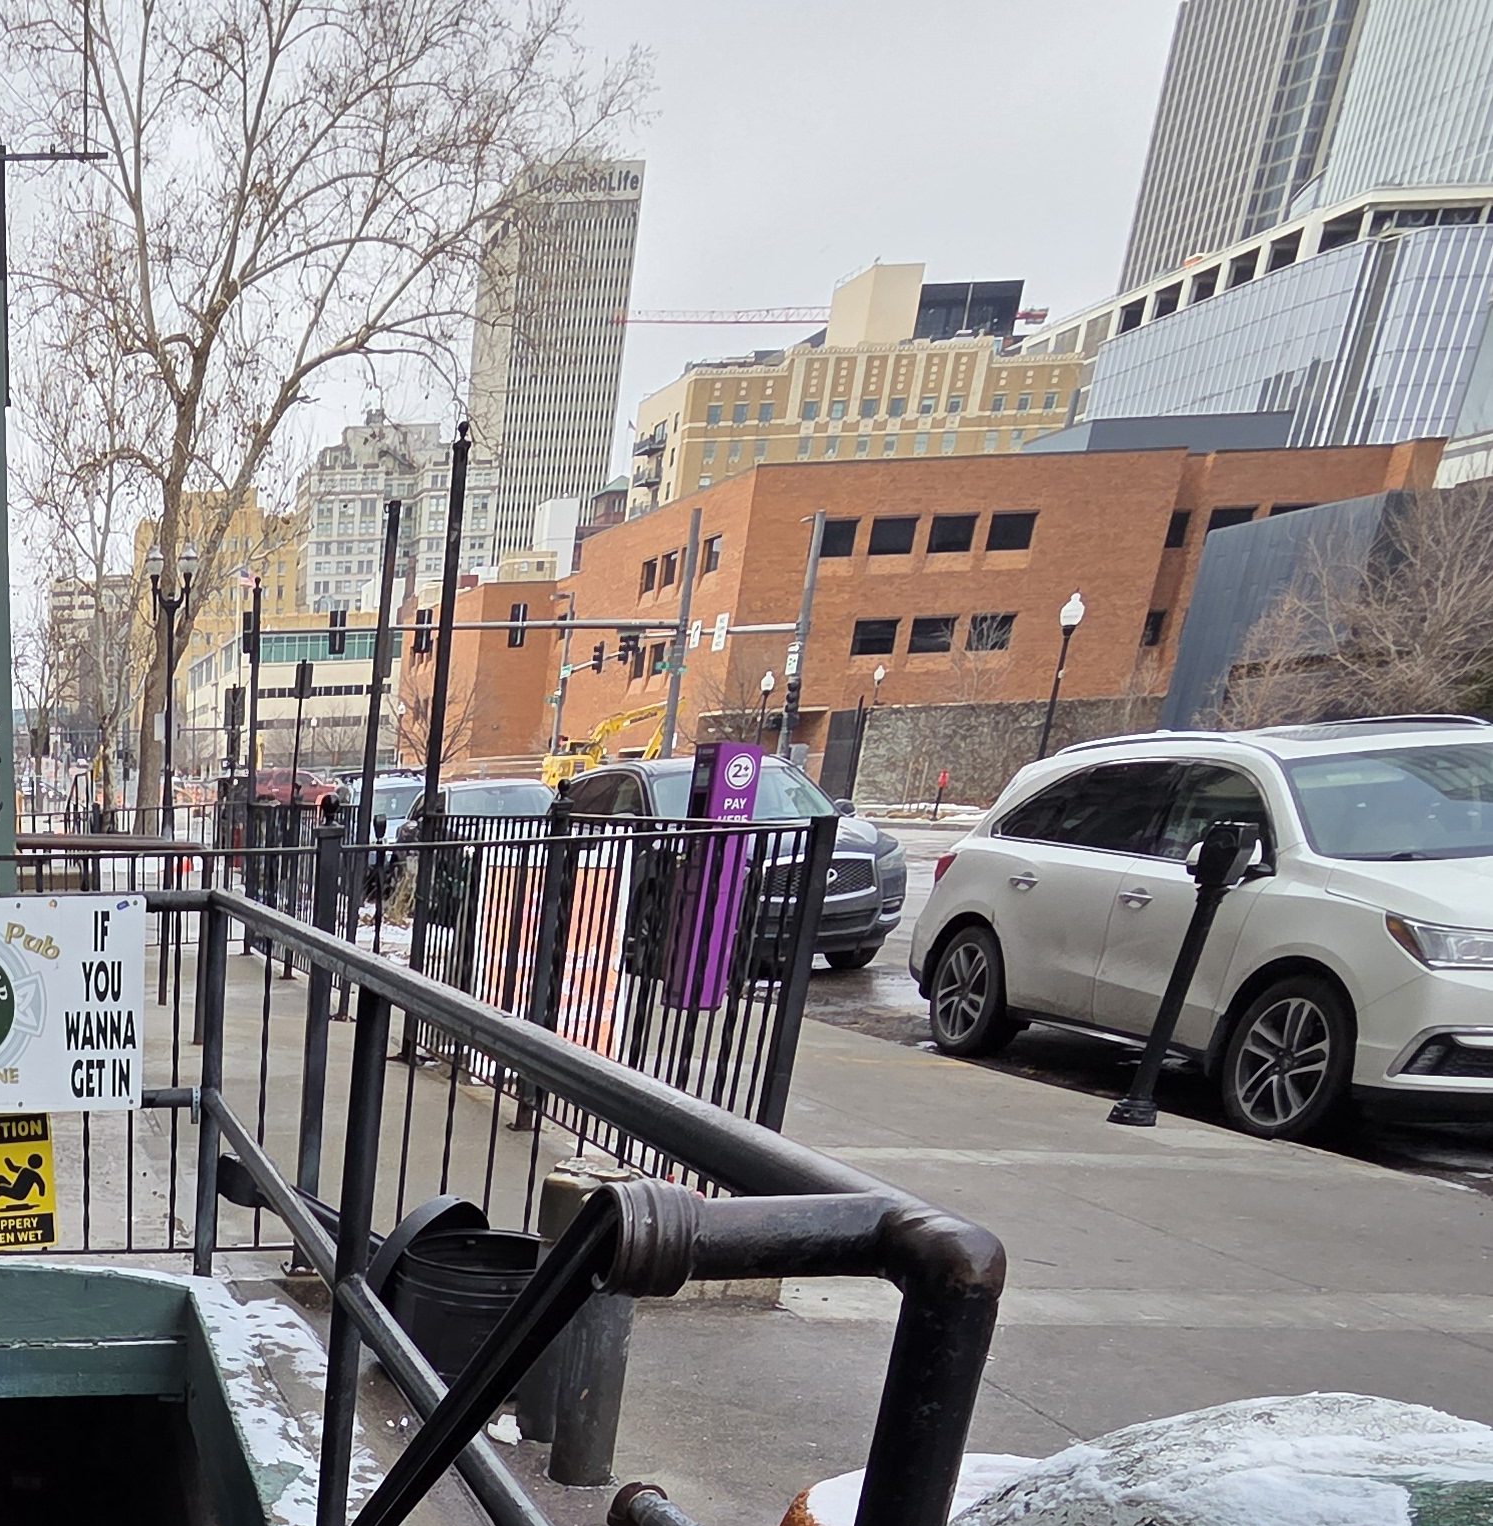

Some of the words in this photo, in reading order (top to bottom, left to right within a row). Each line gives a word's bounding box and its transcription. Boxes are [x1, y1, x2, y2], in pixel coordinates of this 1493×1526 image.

[723, 797, 748, 810] PAY
[5, 921, 61, 960] Pub
[94, 910, 110, 953] IF
[81, 960, 122, 1002] YOU
[64, 1010, 137, 1051] WANNA
[70, 1059, 105, 1099] GET
[110, 1058, 131, 1098] IN
[17, 1230, 44, 1243] WET
